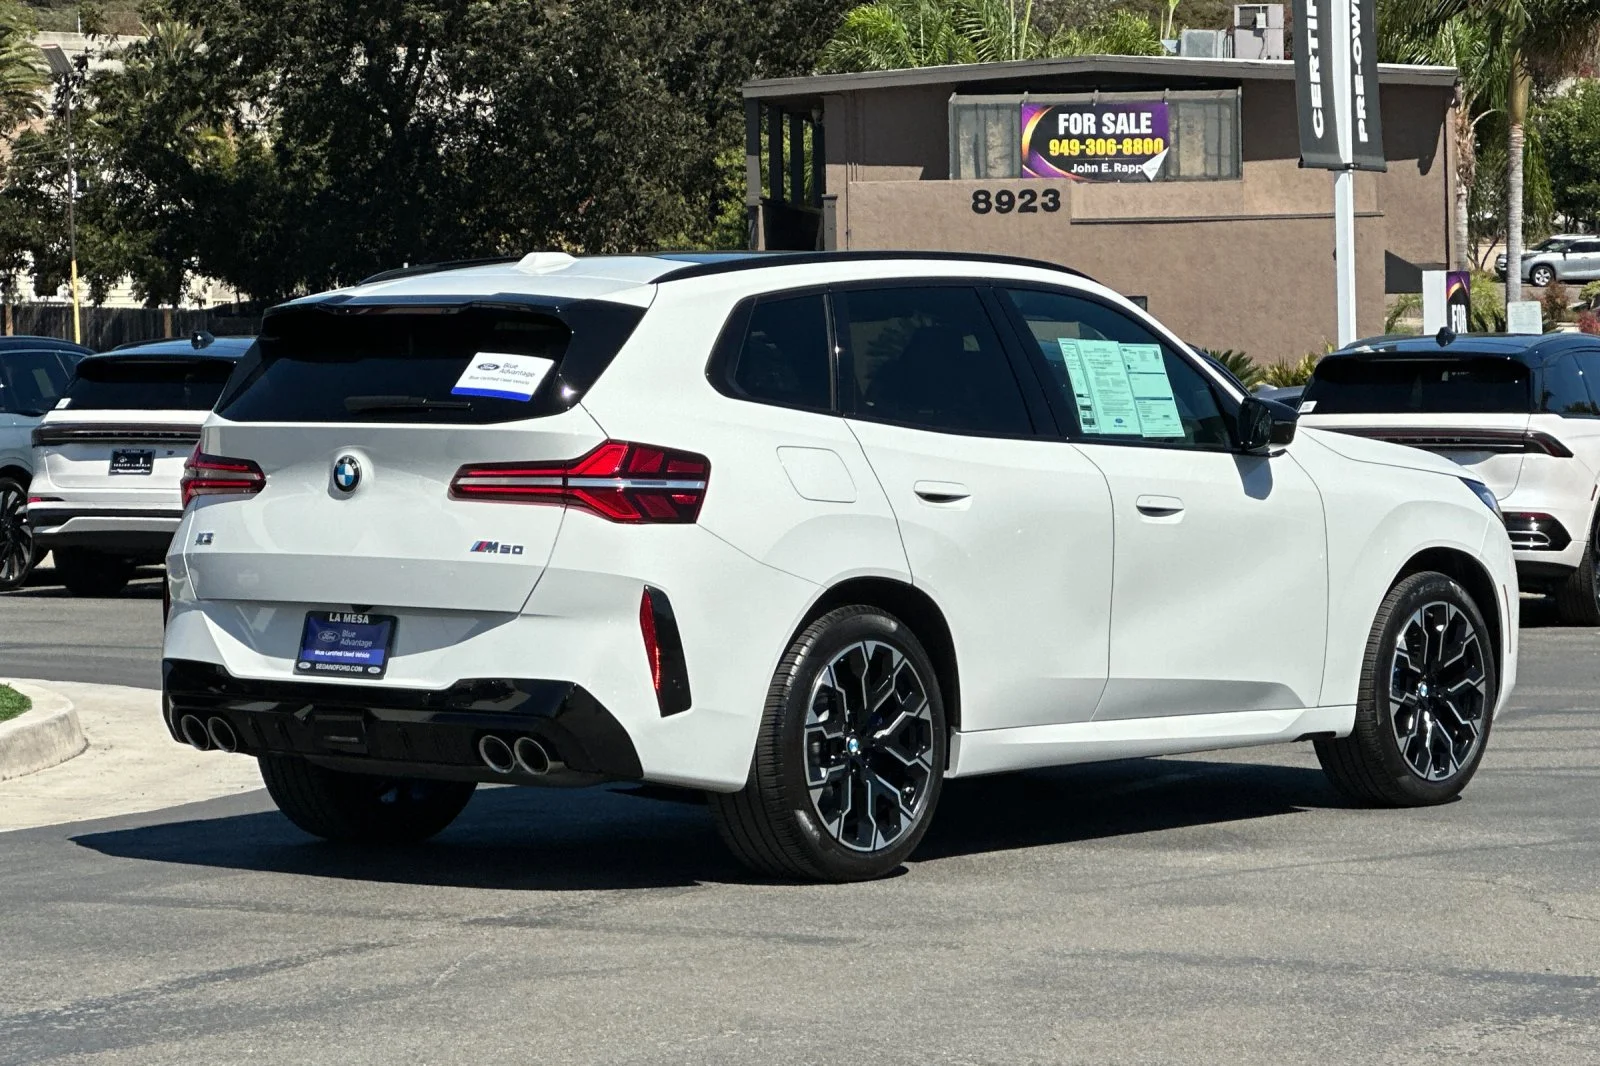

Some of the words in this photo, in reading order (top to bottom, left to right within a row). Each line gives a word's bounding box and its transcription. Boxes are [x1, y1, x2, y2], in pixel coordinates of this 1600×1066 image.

[1351, 0, 1369, 142] PRE-OW
[1058, 113, 1096, 135] FOR
[1102, 112, 1153, 135] SALE
[1049, 138, 1164, 156] 949-306-8800
[1070, 163, 1098, 173] John
[1101, 163, 1112, 173] E.
[971, 188, 1061, 214] 8923
[1451, 304, 1468, 333] FOR
[329, 613, 340, 622] LA
[343, 615, 369, 624] MESA
[342, 629, 357, 639] Blue
[341, 639, 373, 648] Advantage
